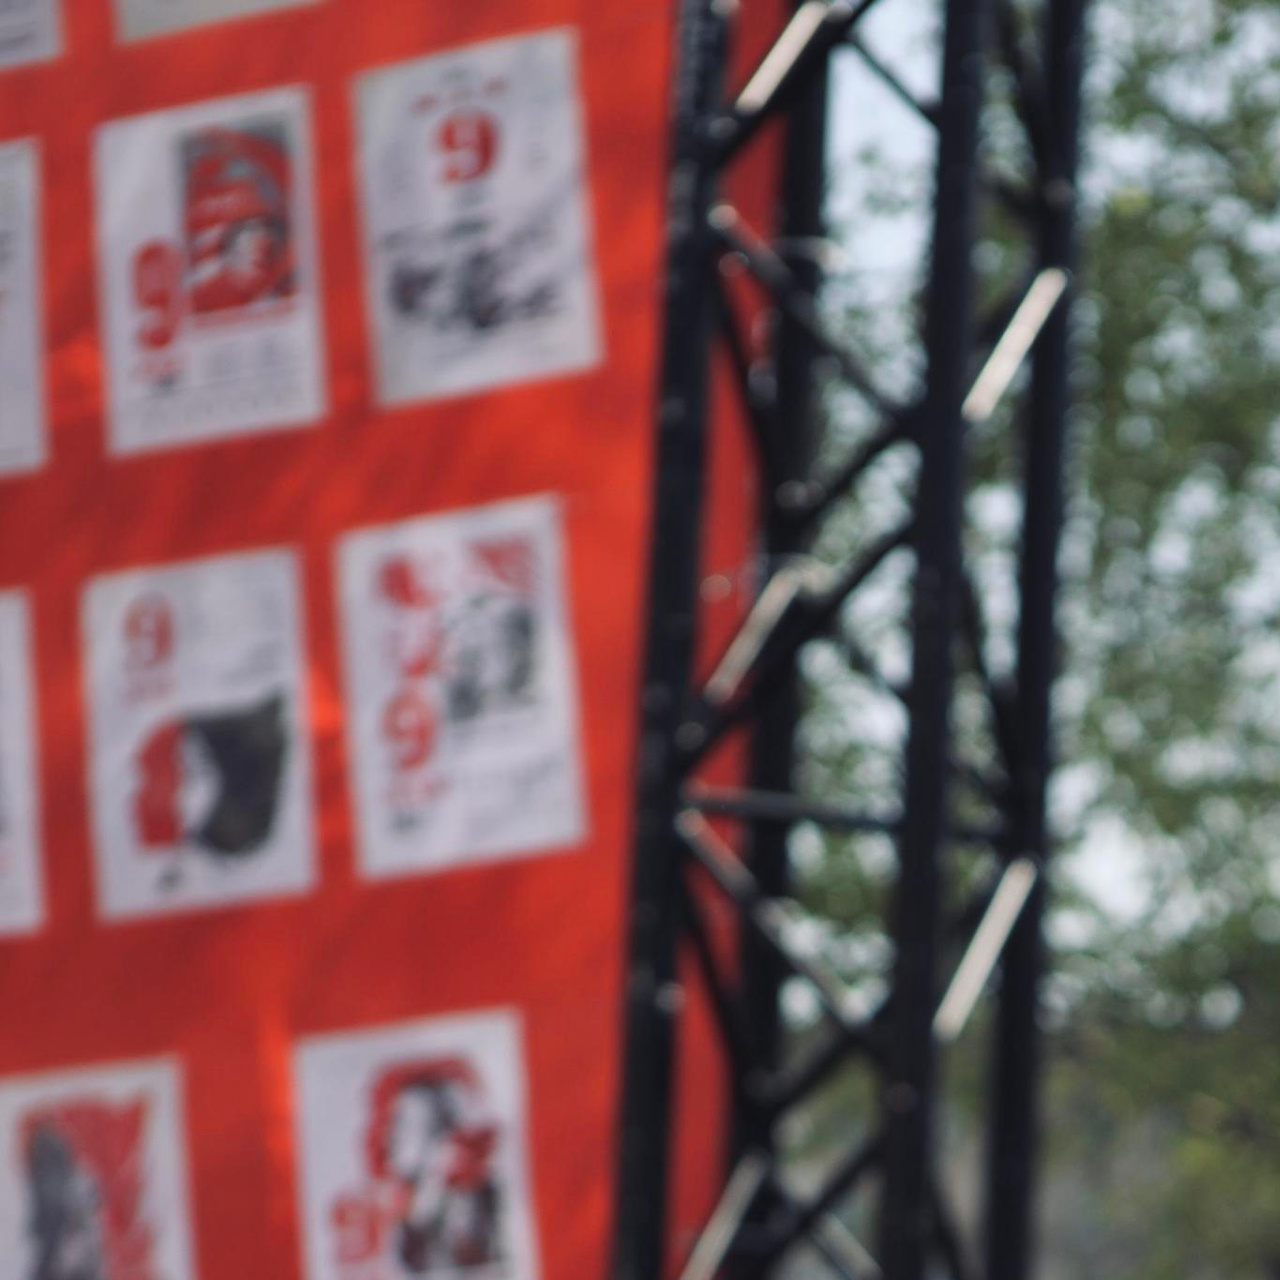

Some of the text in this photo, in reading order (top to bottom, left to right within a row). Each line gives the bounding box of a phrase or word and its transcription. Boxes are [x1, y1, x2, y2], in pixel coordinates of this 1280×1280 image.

[434, 108, 501, 185] 9
[134, 241, 181, 349] 9
[124, 592, 175, 668] 9
[381, 688, 436, 771] 9
